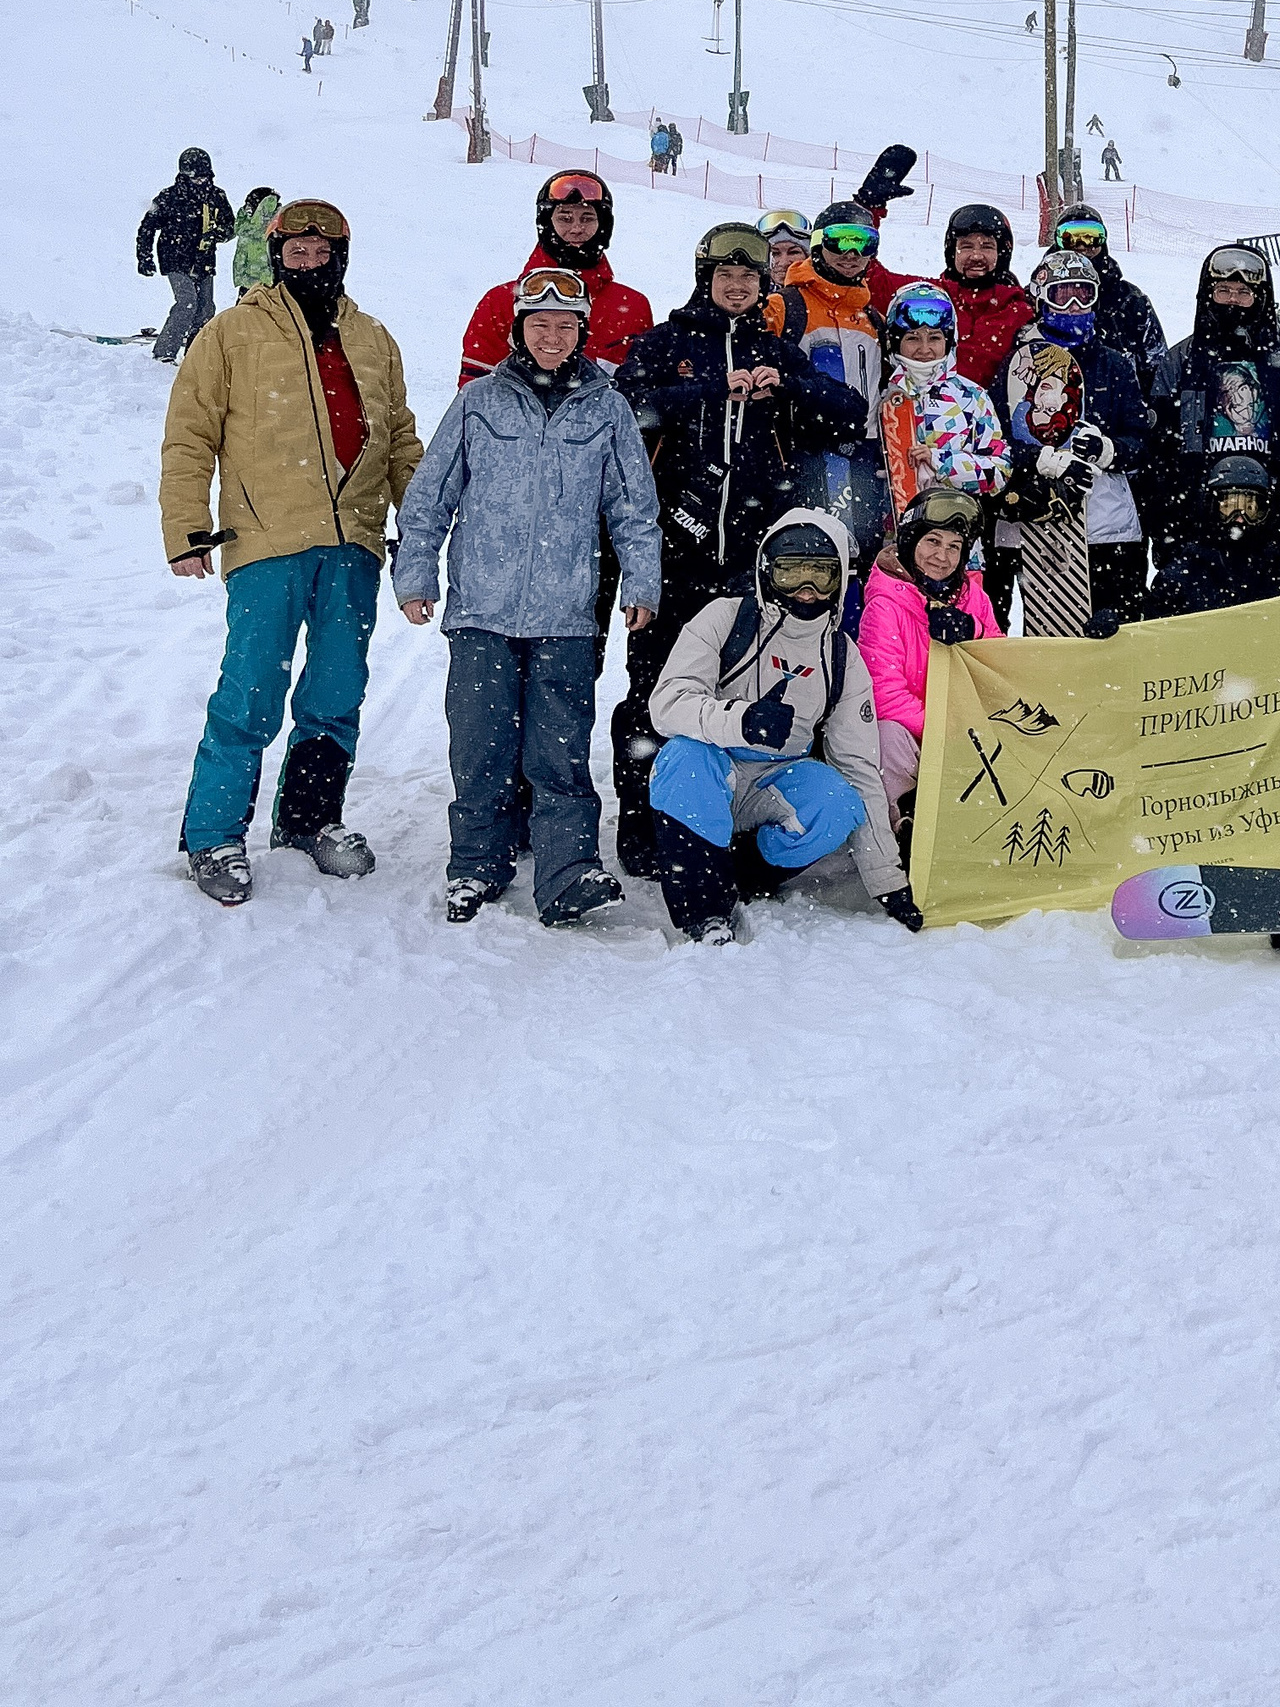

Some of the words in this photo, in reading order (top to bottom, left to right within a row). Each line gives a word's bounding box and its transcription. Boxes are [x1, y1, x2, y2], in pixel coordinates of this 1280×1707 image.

[1209, 436, 1272, 454] WARHOL
[1142, 668, 1227, 702] ВРЕМЯ
[1145, 828, 1203, 855] туры
[1209, 823, 1235, 841] из
